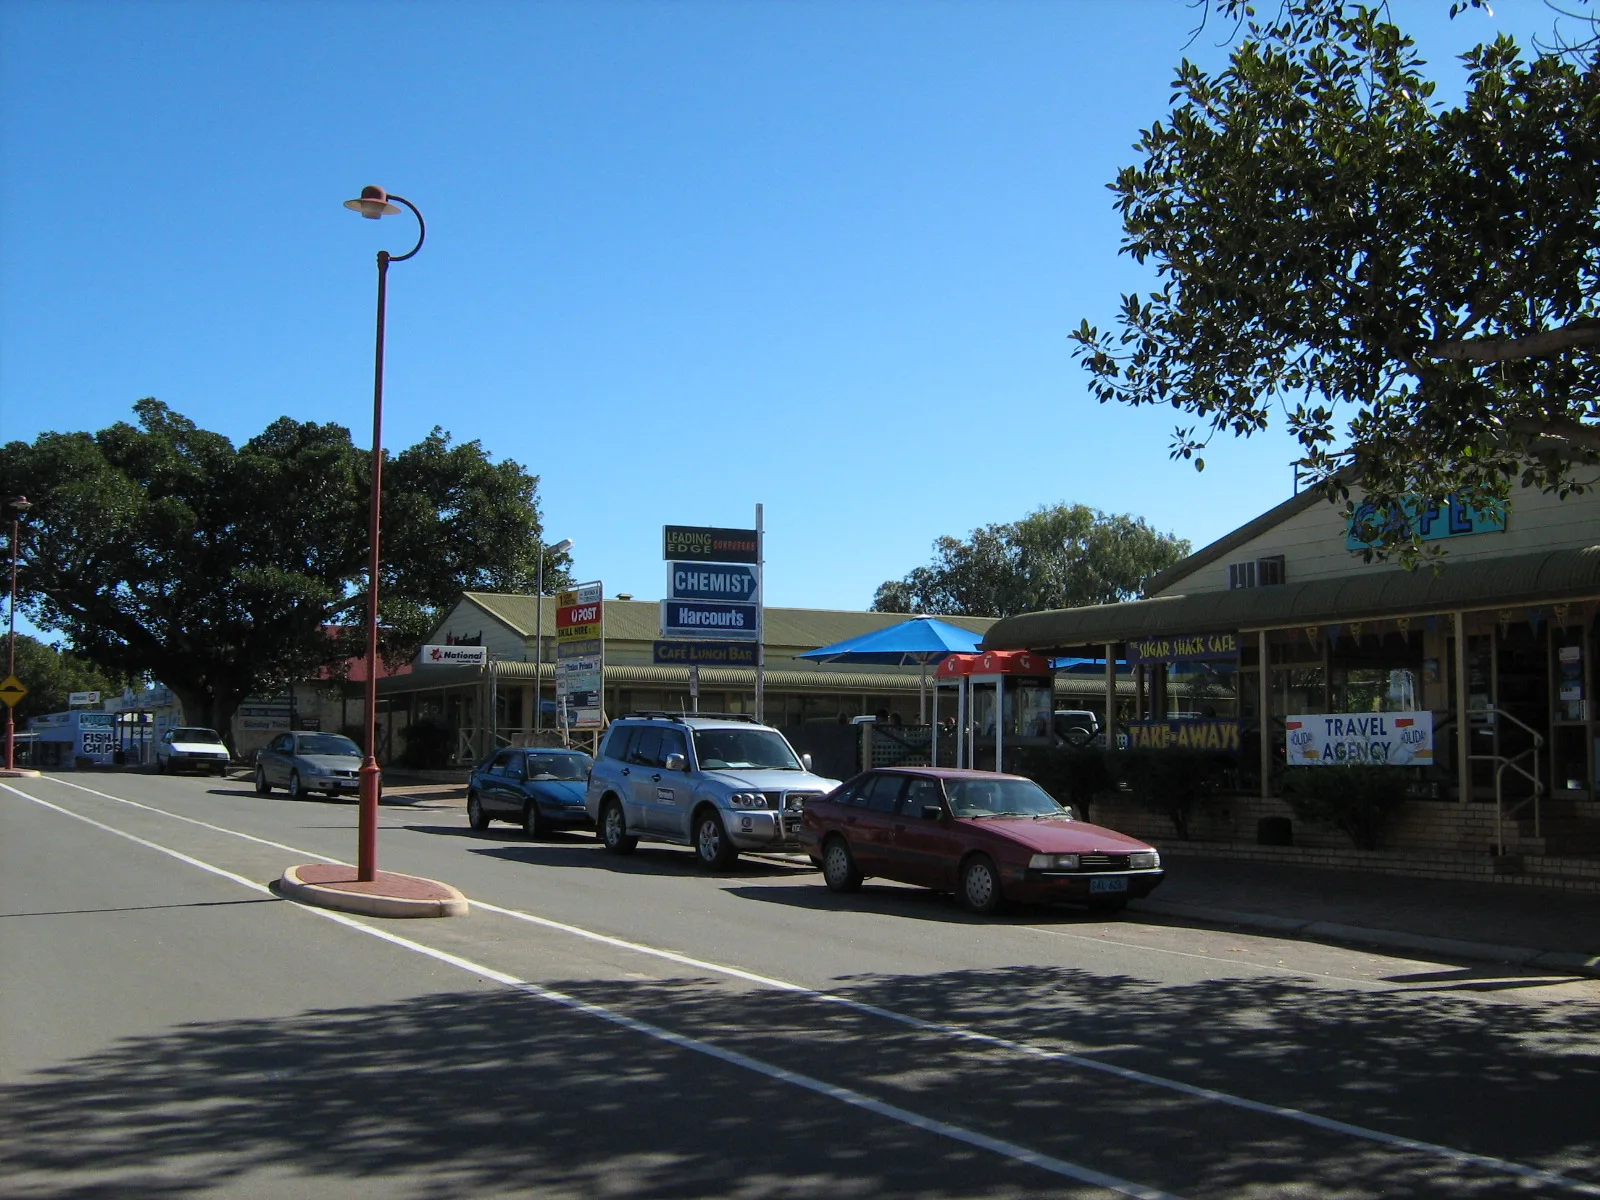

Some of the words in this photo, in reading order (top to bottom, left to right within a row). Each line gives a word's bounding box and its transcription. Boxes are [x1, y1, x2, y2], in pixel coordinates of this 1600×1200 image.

[667, 532, 712, 545] LEADING
[667, 543, 712, 553] EDGE
[674, 571, 751, 593] CHEMIST
[578, 607, 597, 621] POST
[679, 607, 744, 626] Harcourts
[689, 646, 727, 660] LUNCH
[728, 647, 752, 660] BAR
[1140, 641, 1170, 659] SUGAR
[1174, 637, 1204, 656] SHACK
[1207, 634, 1236, 653] CAFE
[444, 652, 482, 660] National
[1325, 718, 1387, 736] TRAVEL
[83, 733, 111, 743] FISH
[1129, 722, 1239, 750] TAKE-AWAYS
[1323, 741, 1391, 760] AGENCY
